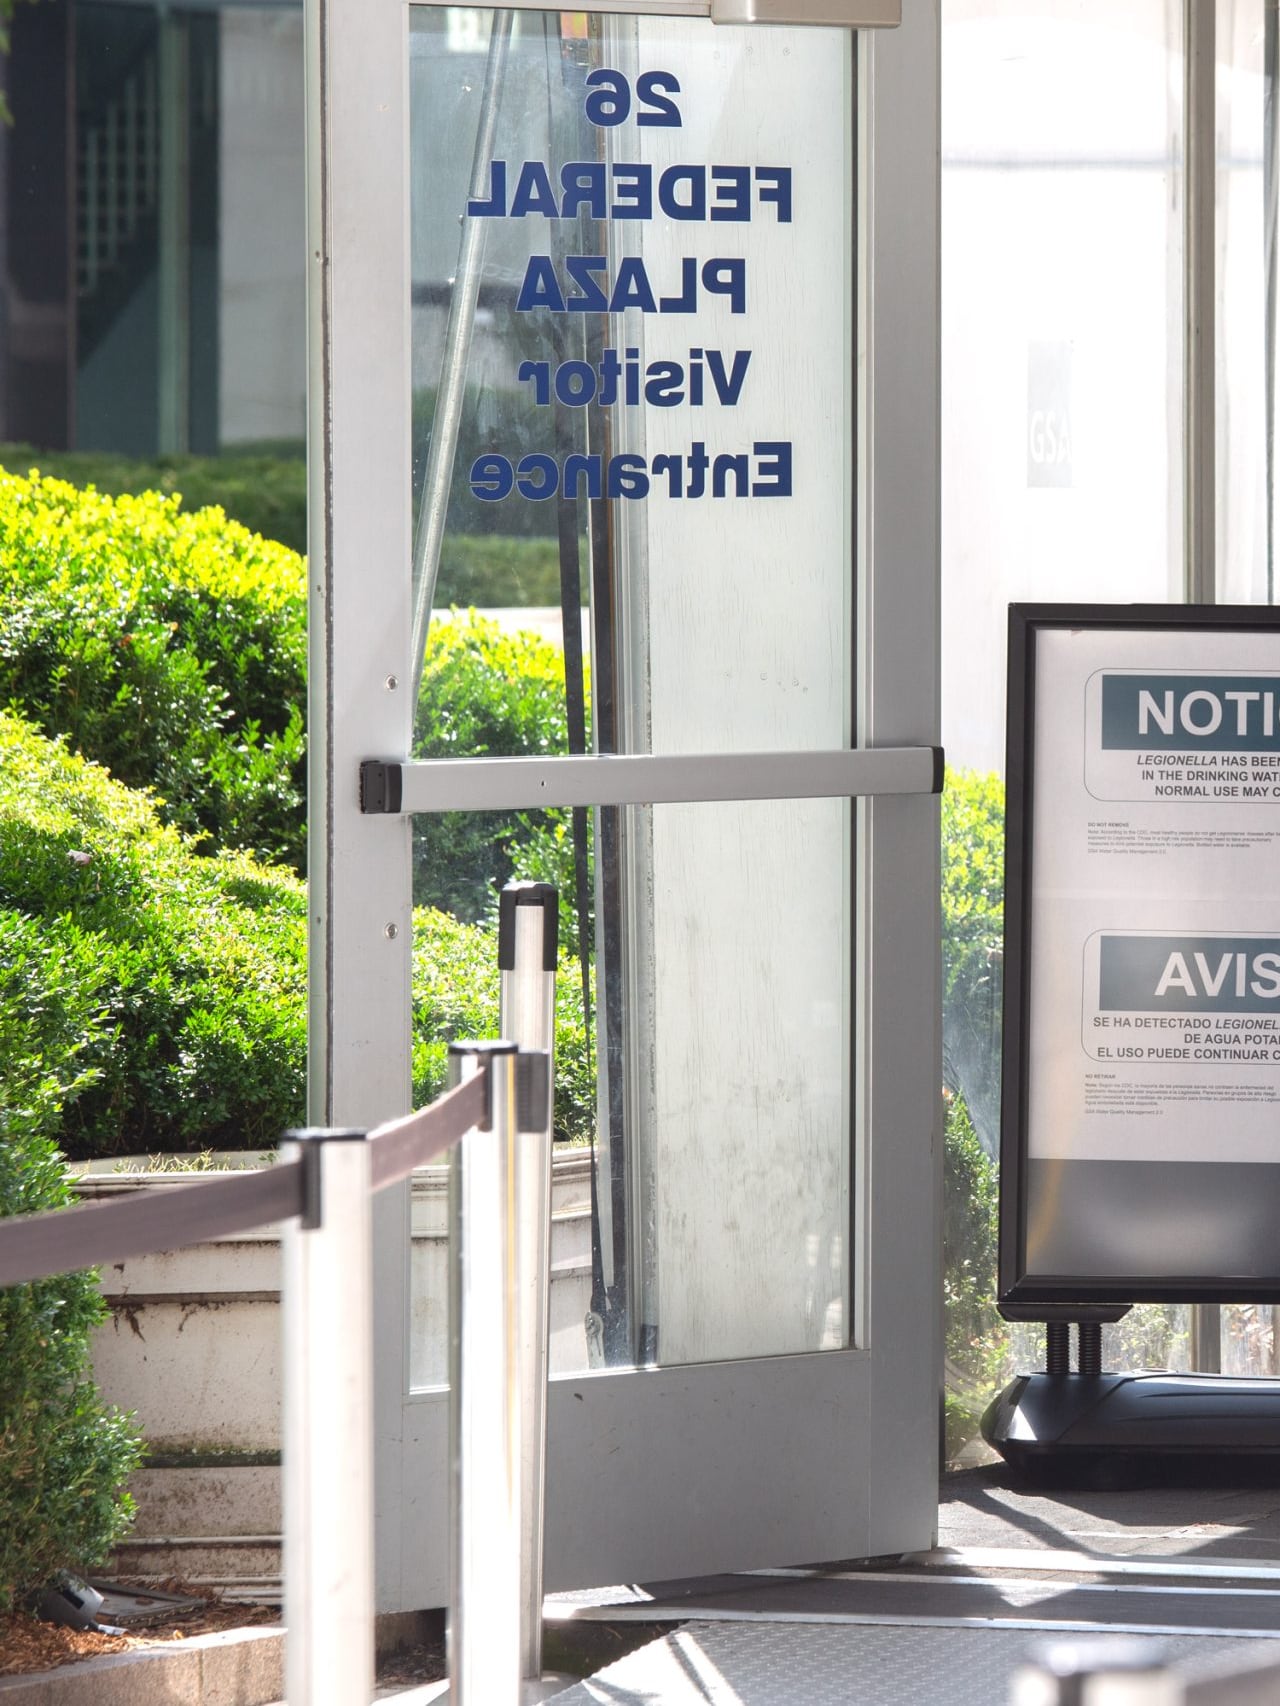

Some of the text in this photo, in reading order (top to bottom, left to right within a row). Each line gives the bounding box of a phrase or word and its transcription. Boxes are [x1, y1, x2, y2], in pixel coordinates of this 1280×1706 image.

[1137, 755, 1217, 766] LEGIONELLA
[1221, 756, 1248, 766] HAS
[1142, 770, 1154, 780] IN
[1158, 770, 1183, 781] THE
[1186, 770, 1248, 782] DRINKING
[1155, 785, 1210, 796] NORMAL
[1213, 786, 1239, 797] USE
[1242, 786, 1269, 797] MAY
[1093, 1017, 1109, 1027] SE
[1113, 1017, 1131, 1027] HA
[1134, 1018, 1211, 1029] DETECTADO
[1184, 1033, 1201, 1043] DE
[1204, 1034, 1241, 1044] AGUA
[1097, 1047, 1113, 1057] EL
[1117, 1047, 1144, 1058] USO
[1147, 1048, 1190, 1058] PUEDE
[1193, 1049, 1269, 1060] CONTINUAR
